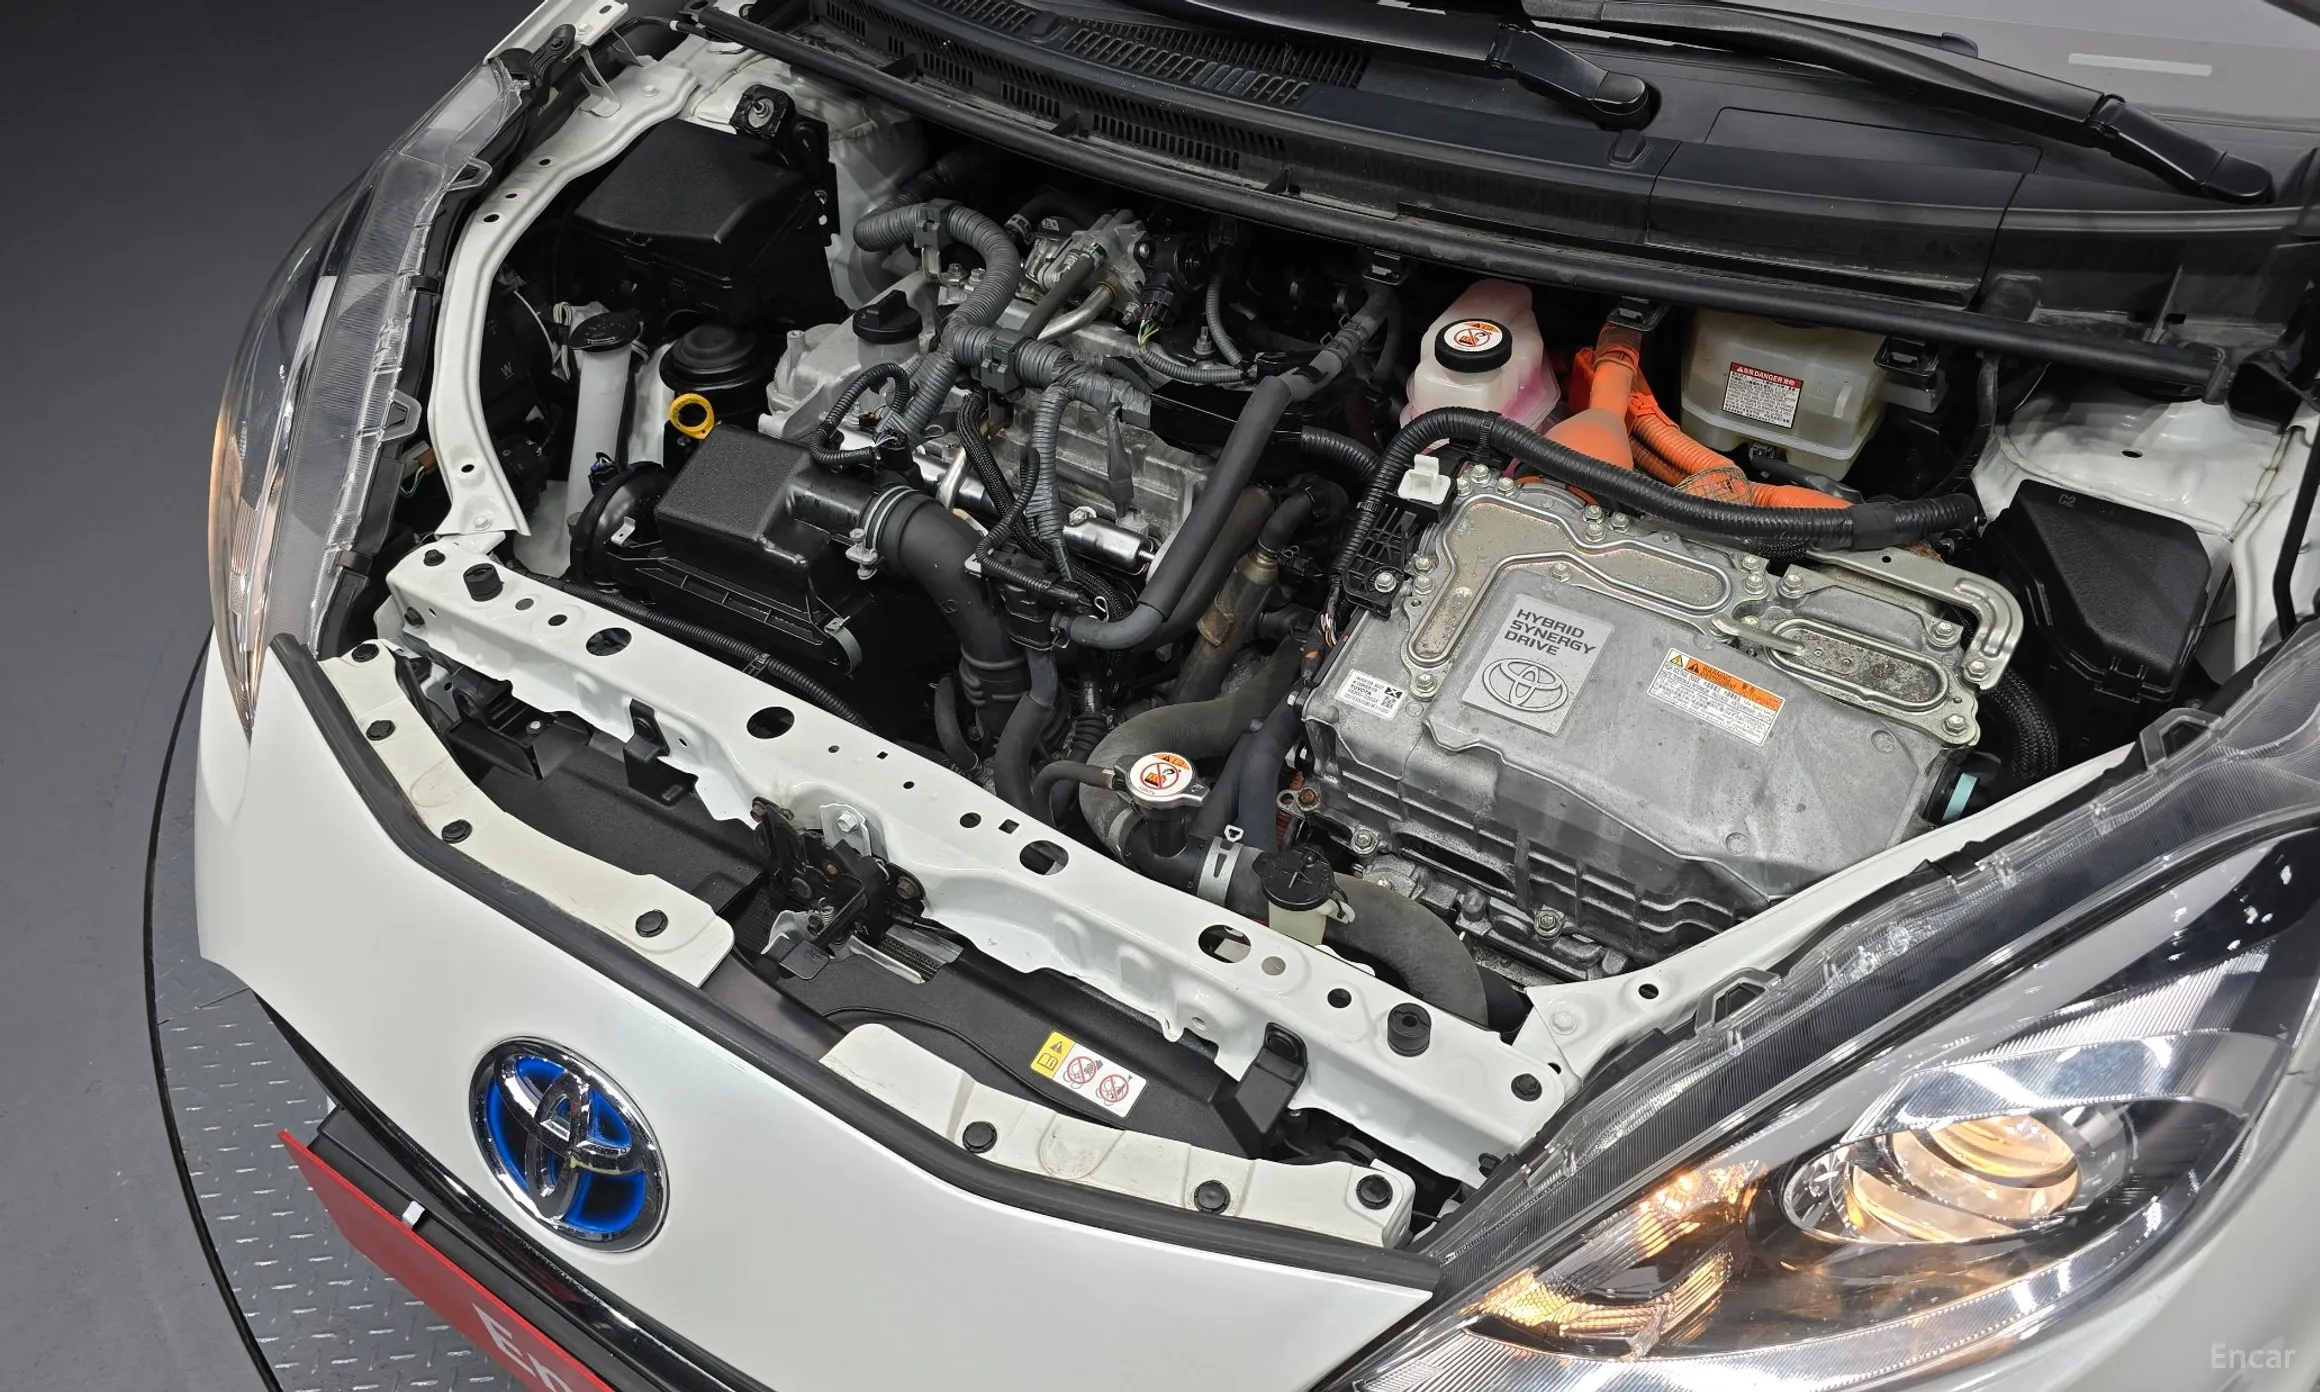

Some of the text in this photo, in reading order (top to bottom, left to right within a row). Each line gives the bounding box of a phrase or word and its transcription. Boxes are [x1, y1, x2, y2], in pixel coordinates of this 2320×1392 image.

[1754, 370, 1783, 383] DANGER
[1510, 620, 1596, 654] SYNERGY
[1516, 609, 1584, 638] HYBRID
[1504, 630, 1560, 656] DRIVE
